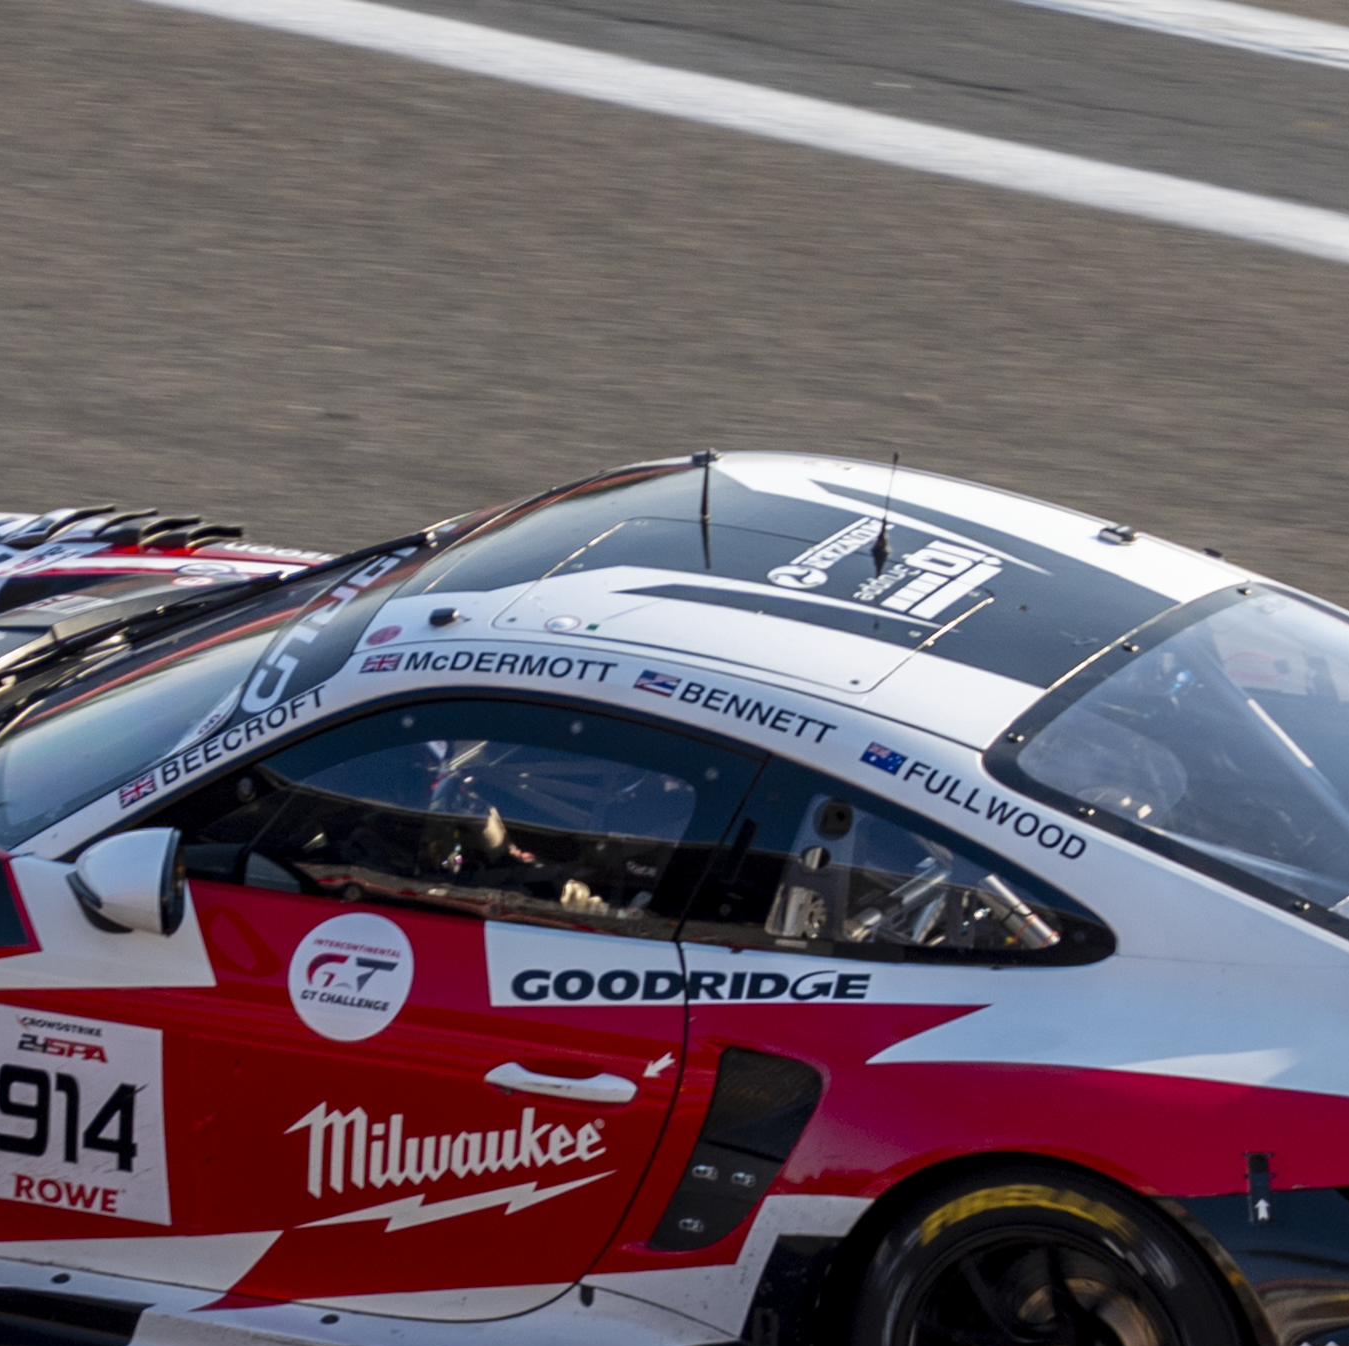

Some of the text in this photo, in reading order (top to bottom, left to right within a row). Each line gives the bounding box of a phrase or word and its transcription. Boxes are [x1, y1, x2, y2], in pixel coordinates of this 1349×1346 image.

[403, 650, 618, 683] McDERMOTT
[677, 681, 838, 744] BENNETT
[160, 684, 325, 786] BEECROFT
[903, 760, 1089, 862] FULLWOOD
[319, 991, 391, 1012] CHALLENGE
[511, 968, 872, 1002] GOODRIDGE
[20, 1016, 103, 1038] CROWDSTRIKE
[284, 1101, 608, 1198] Milwaukee
[14, 1173, 119, 1214] ROWE
